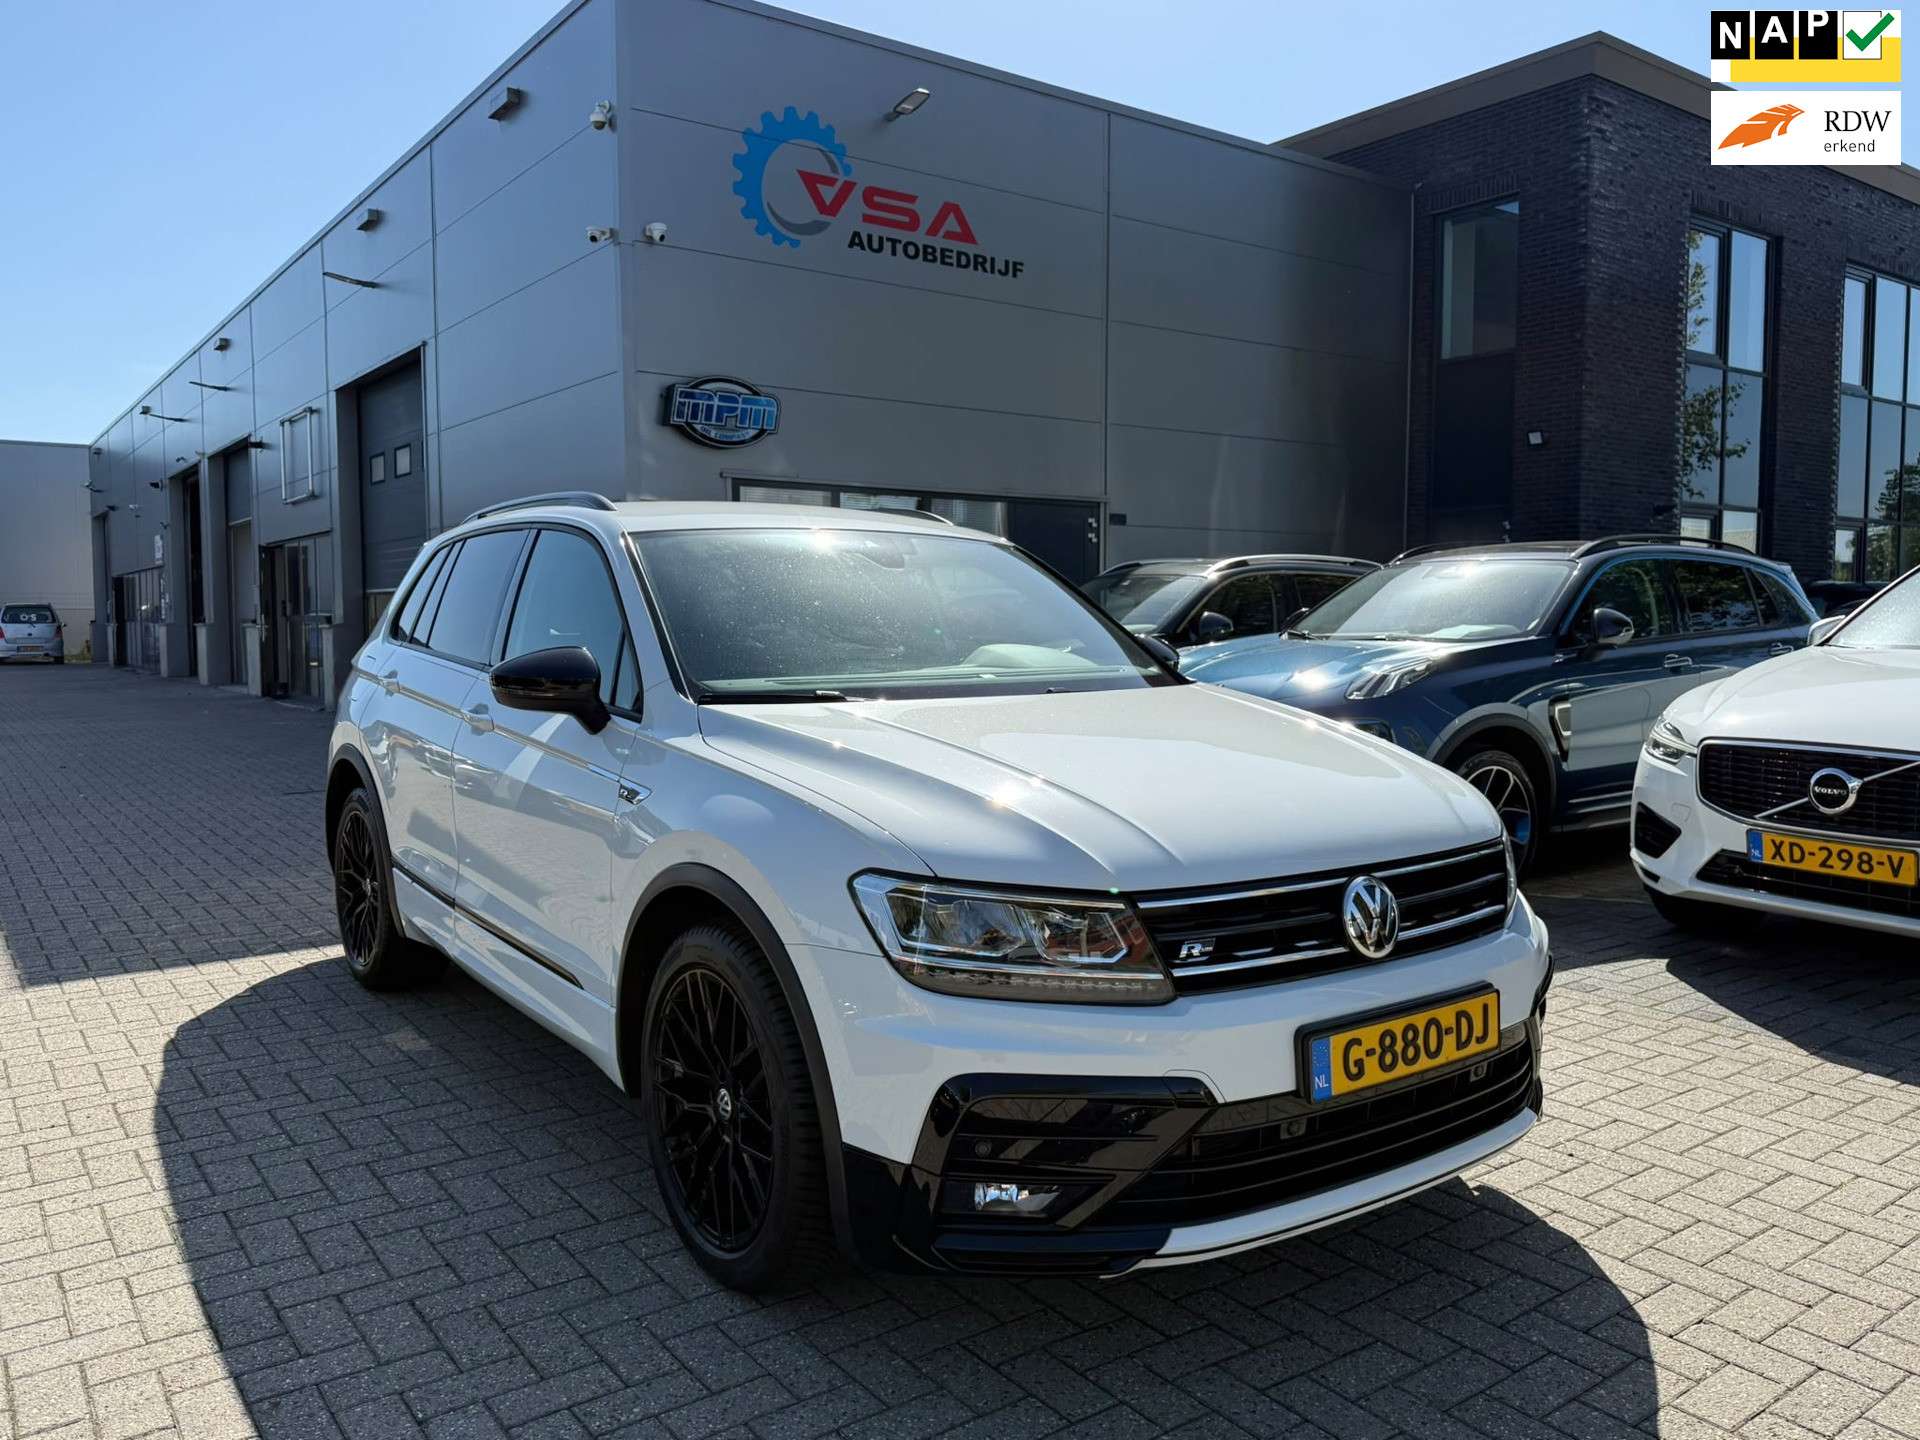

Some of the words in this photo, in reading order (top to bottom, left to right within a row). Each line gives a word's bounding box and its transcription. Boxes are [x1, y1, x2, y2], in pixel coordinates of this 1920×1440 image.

[796, 168, 978, 245] VSA
[847, 230, 1025, 279] AUTOBEDRIJF
[1814, 785, 1847, 796] VOLVO
[1770, 838, 1904, 880] XD-298-V
[1314, 1074, 1329, 1089] NL
[1342, 1003, 1489, 1082] G-880-DJ
